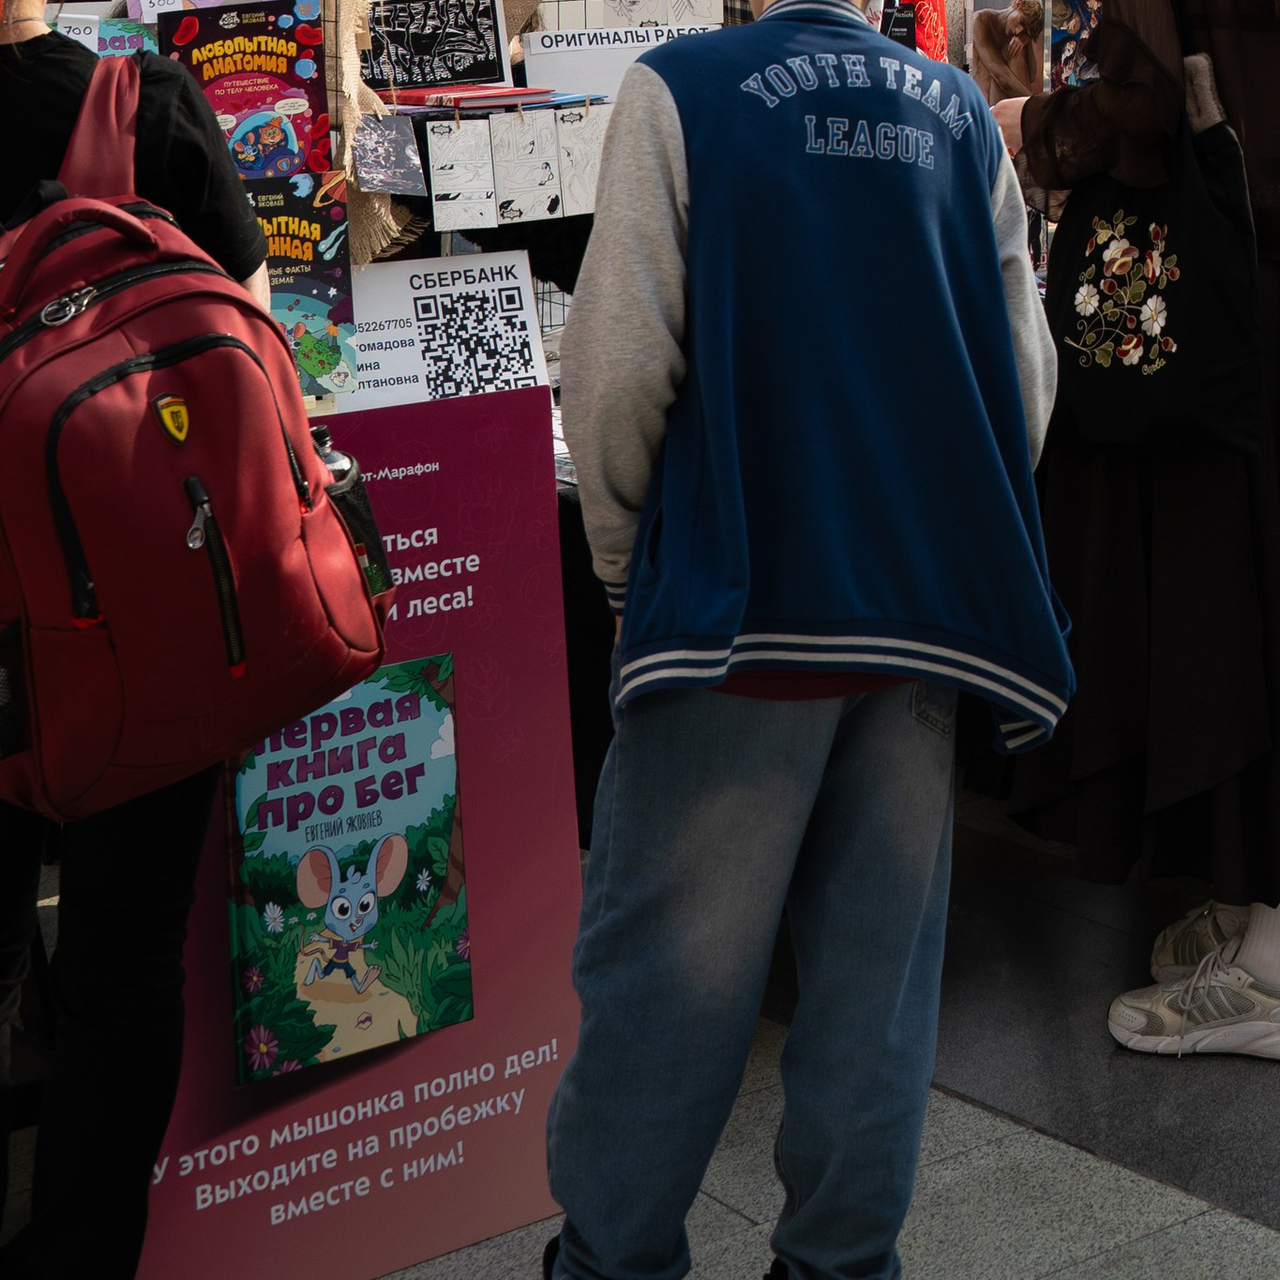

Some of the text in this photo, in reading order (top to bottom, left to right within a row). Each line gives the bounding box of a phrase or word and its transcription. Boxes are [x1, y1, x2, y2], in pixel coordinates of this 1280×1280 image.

[63, 25, 93, 36] 700
[540, 29, 651, 49] ОРИГИНАЛЫ
[191, 35, 298, 65] ЛЮБОПЫТНАЯ
[202, 54, 288, 81] АНАТОМИЯ
[223, 76, 270, 88] ПУТЕШЕСТВИЕ
[227, 86, 244, 94] ТЕЛУ
[245, 83, 279, 93] ЧЕЛОВЕКА
[740, 53, 974, 141] YOUTH TEAM
[804, 114, 934, 170] LEAGUE
[270, 276, 294, 286] ЗЕМЛЕ
[285, 265, 312, 274] ФАКТЫ
[409, 264, 519, 291] СБЕРБАНК
[390, 553, 480, 586] вместе
[407, 585, 474, 619] леса!
[266, 732, 407, 792] книга
[257, 784, 345, 832] про
[305, 809, 383, 843] ЕВГЕНИЙ ЯКОВЛЕВ
[178, 1132, 260, 1177] этого
[269, 1089, 404, 1149] мышонка
[413, 1062, 496, 1103] полно
[504, 1038, 559, 1080] дел!
[195, 1087, 526, 1211] Выходите на пробежку
[270, 1140, 465, 1226] вместе с ним!
